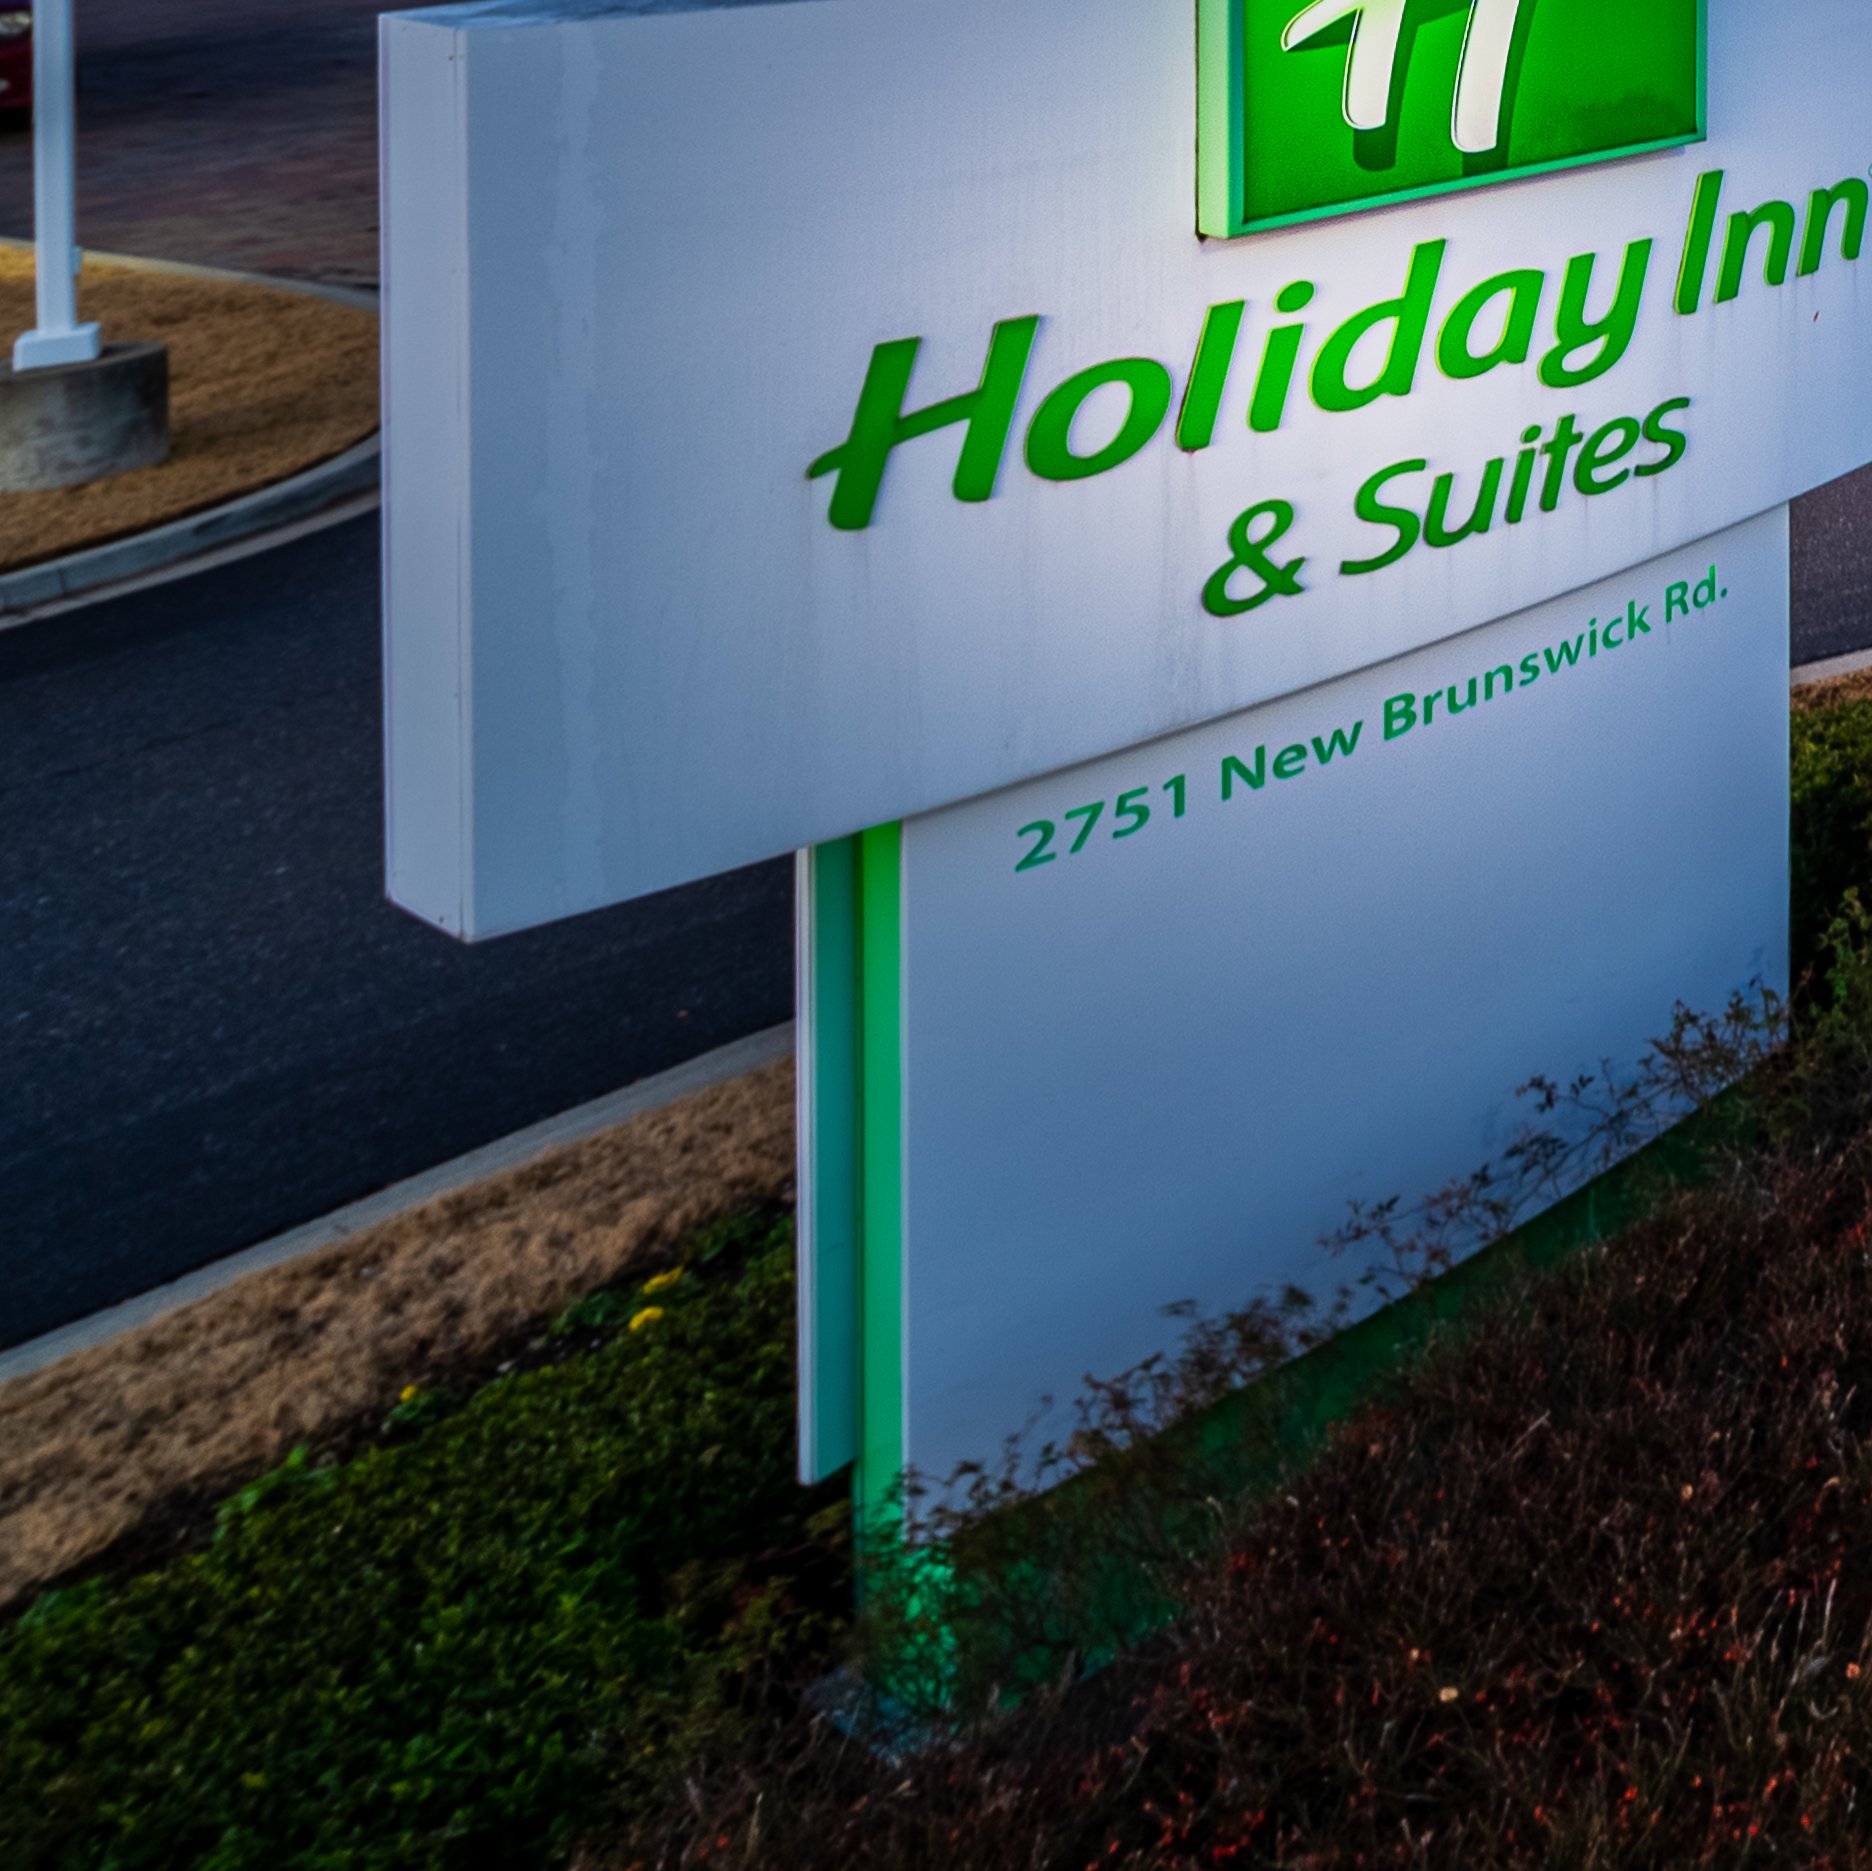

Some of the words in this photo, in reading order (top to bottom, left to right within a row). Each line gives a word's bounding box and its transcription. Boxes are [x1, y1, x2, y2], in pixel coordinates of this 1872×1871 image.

[806, 238, 1654, 531] Holiday
[1674, 169, 1869, 315] Inn
[1200, 498, 1306, 617] &
[1339, 397, 1690, 575] Suites
[1013, 774, 1187, 872] 2751
[1219, 719, 1364, 802] New
[1382, 600, 1652, 741] Brunswick
[1664, 564, 1728, 624] Rd.
